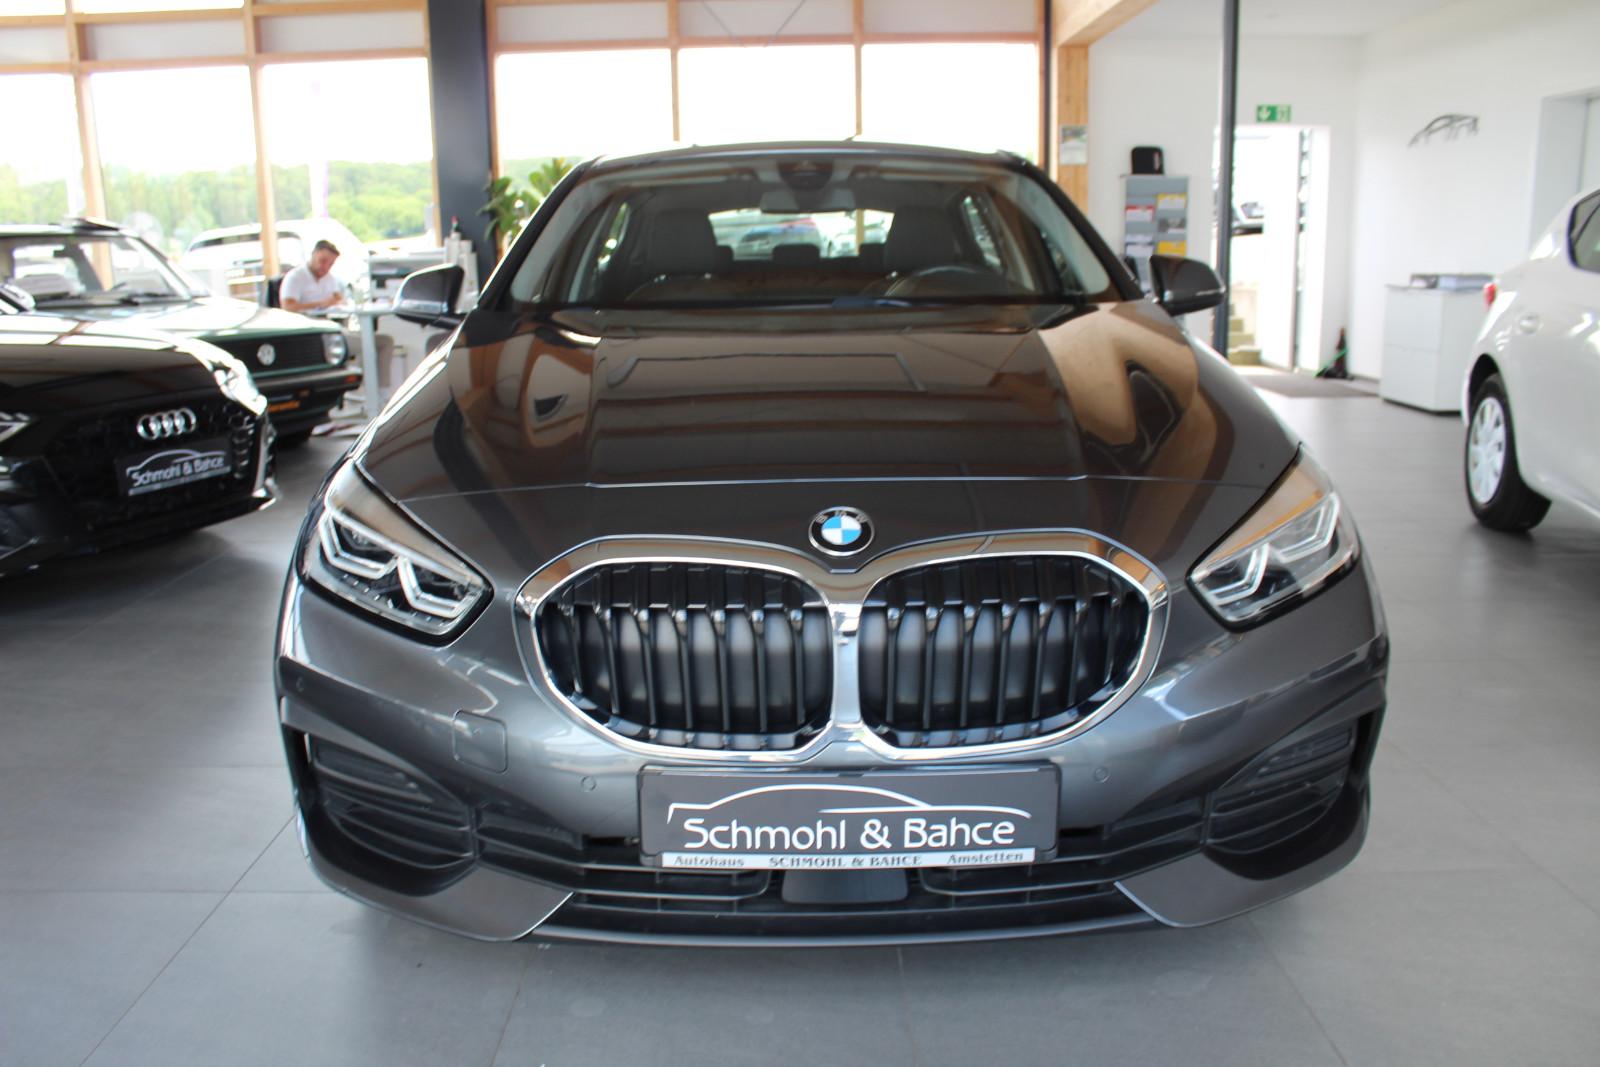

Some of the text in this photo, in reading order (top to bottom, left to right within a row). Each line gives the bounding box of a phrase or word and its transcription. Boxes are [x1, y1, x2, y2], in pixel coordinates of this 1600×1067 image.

[131, 463, 180, 487] Schmohl
[183, 461, 193, 475] &
[684, 817, 1016, 850] Schmohl & Bahce
[674, 852, 1024, 868] Autohaus SCHMOHL & BAHCE Amstetten
